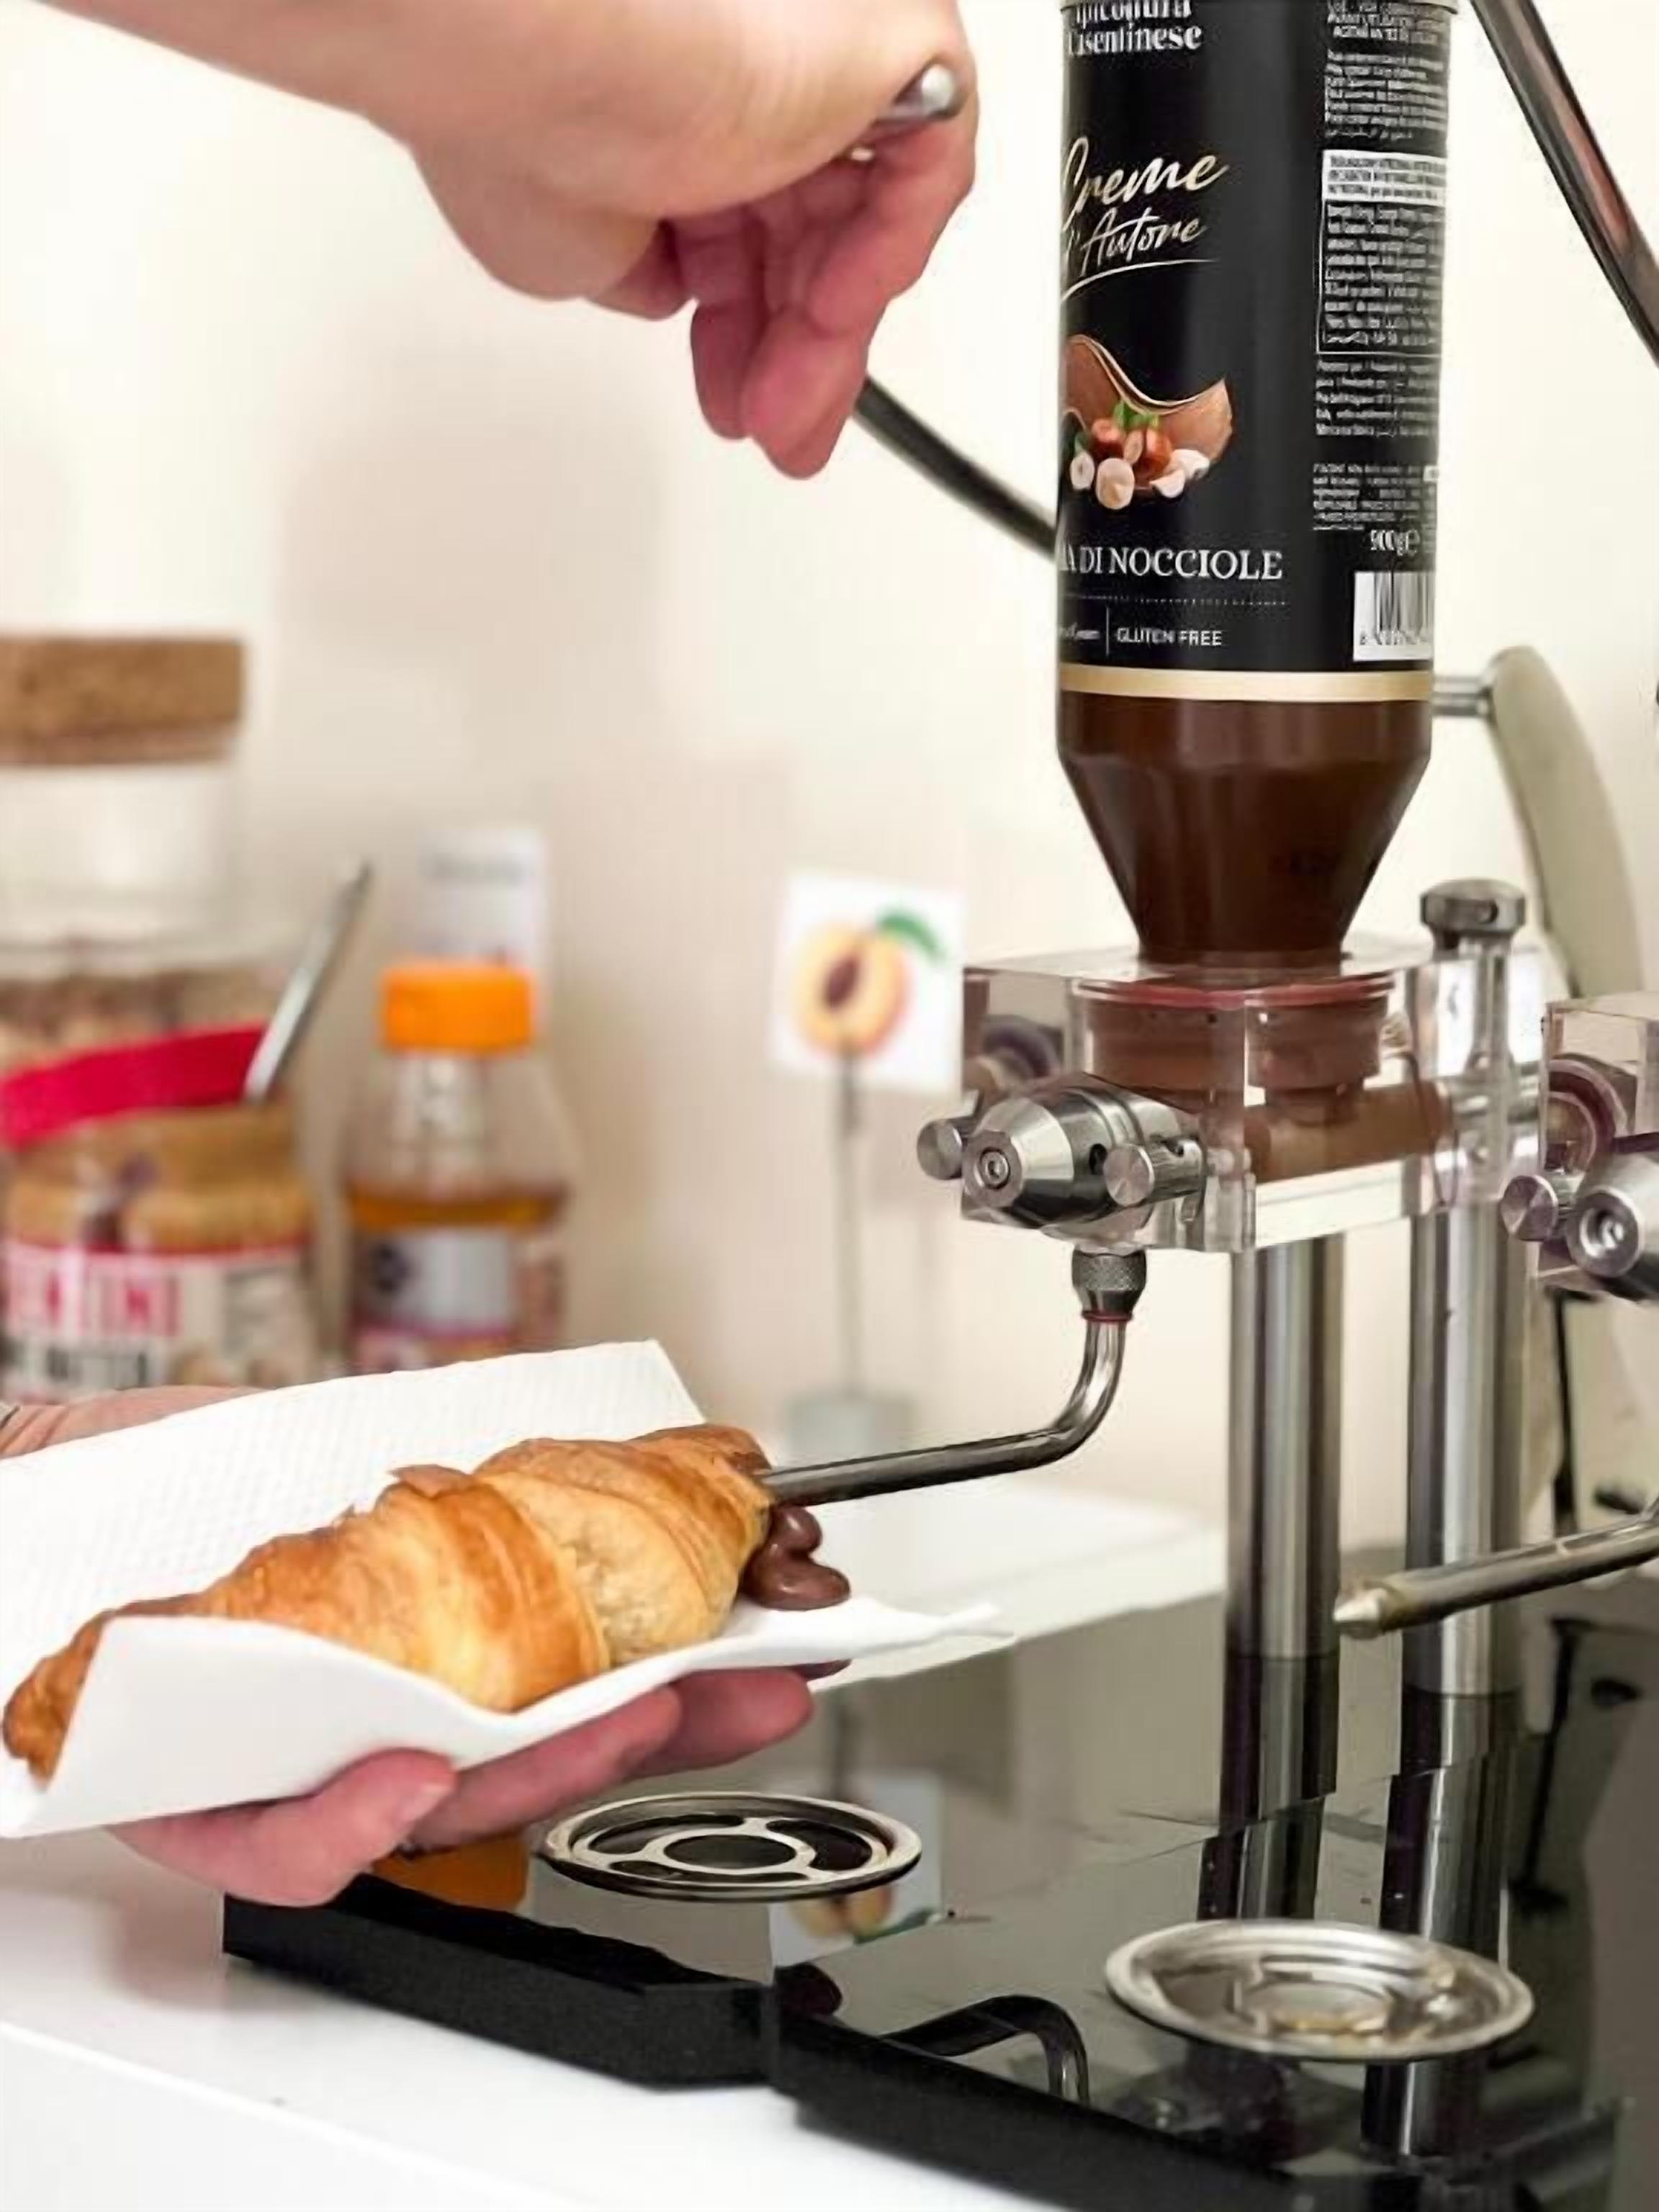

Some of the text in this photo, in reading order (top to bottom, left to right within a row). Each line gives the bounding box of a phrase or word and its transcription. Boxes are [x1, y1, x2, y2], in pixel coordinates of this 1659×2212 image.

[1079, 546, 1103, 574] DI
[1109, 547, 1282, 580] NOCCIOLE
[1117, 627, 1174, 643] GLUTEN
[1179, 630, 1223, 646] FREE
